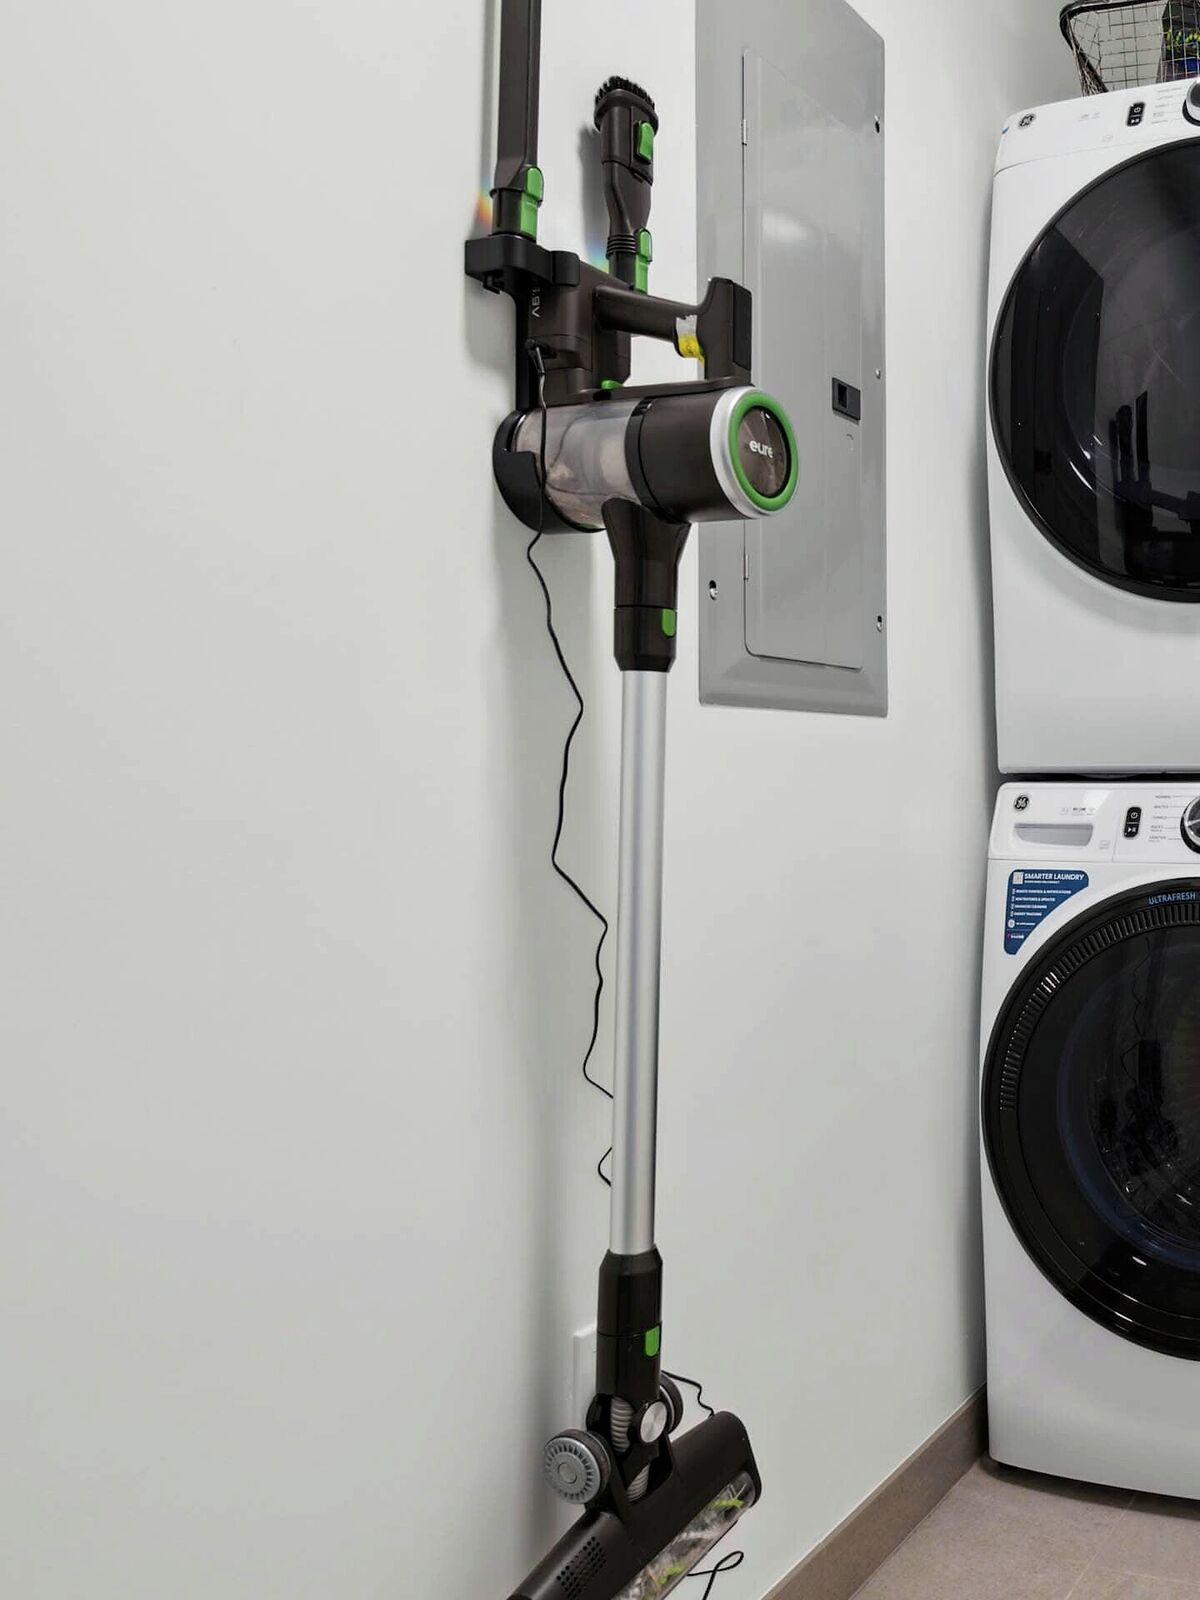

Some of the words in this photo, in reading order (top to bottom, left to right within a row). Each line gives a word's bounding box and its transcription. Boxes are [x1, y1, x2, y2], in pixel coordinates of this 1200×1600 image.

[1024, 873, 1053, 881] SMARTER
[1053, 873, 1085, 881] LAUNDRY
[1148, 892, 1196, 905] ULTRAFRESH
